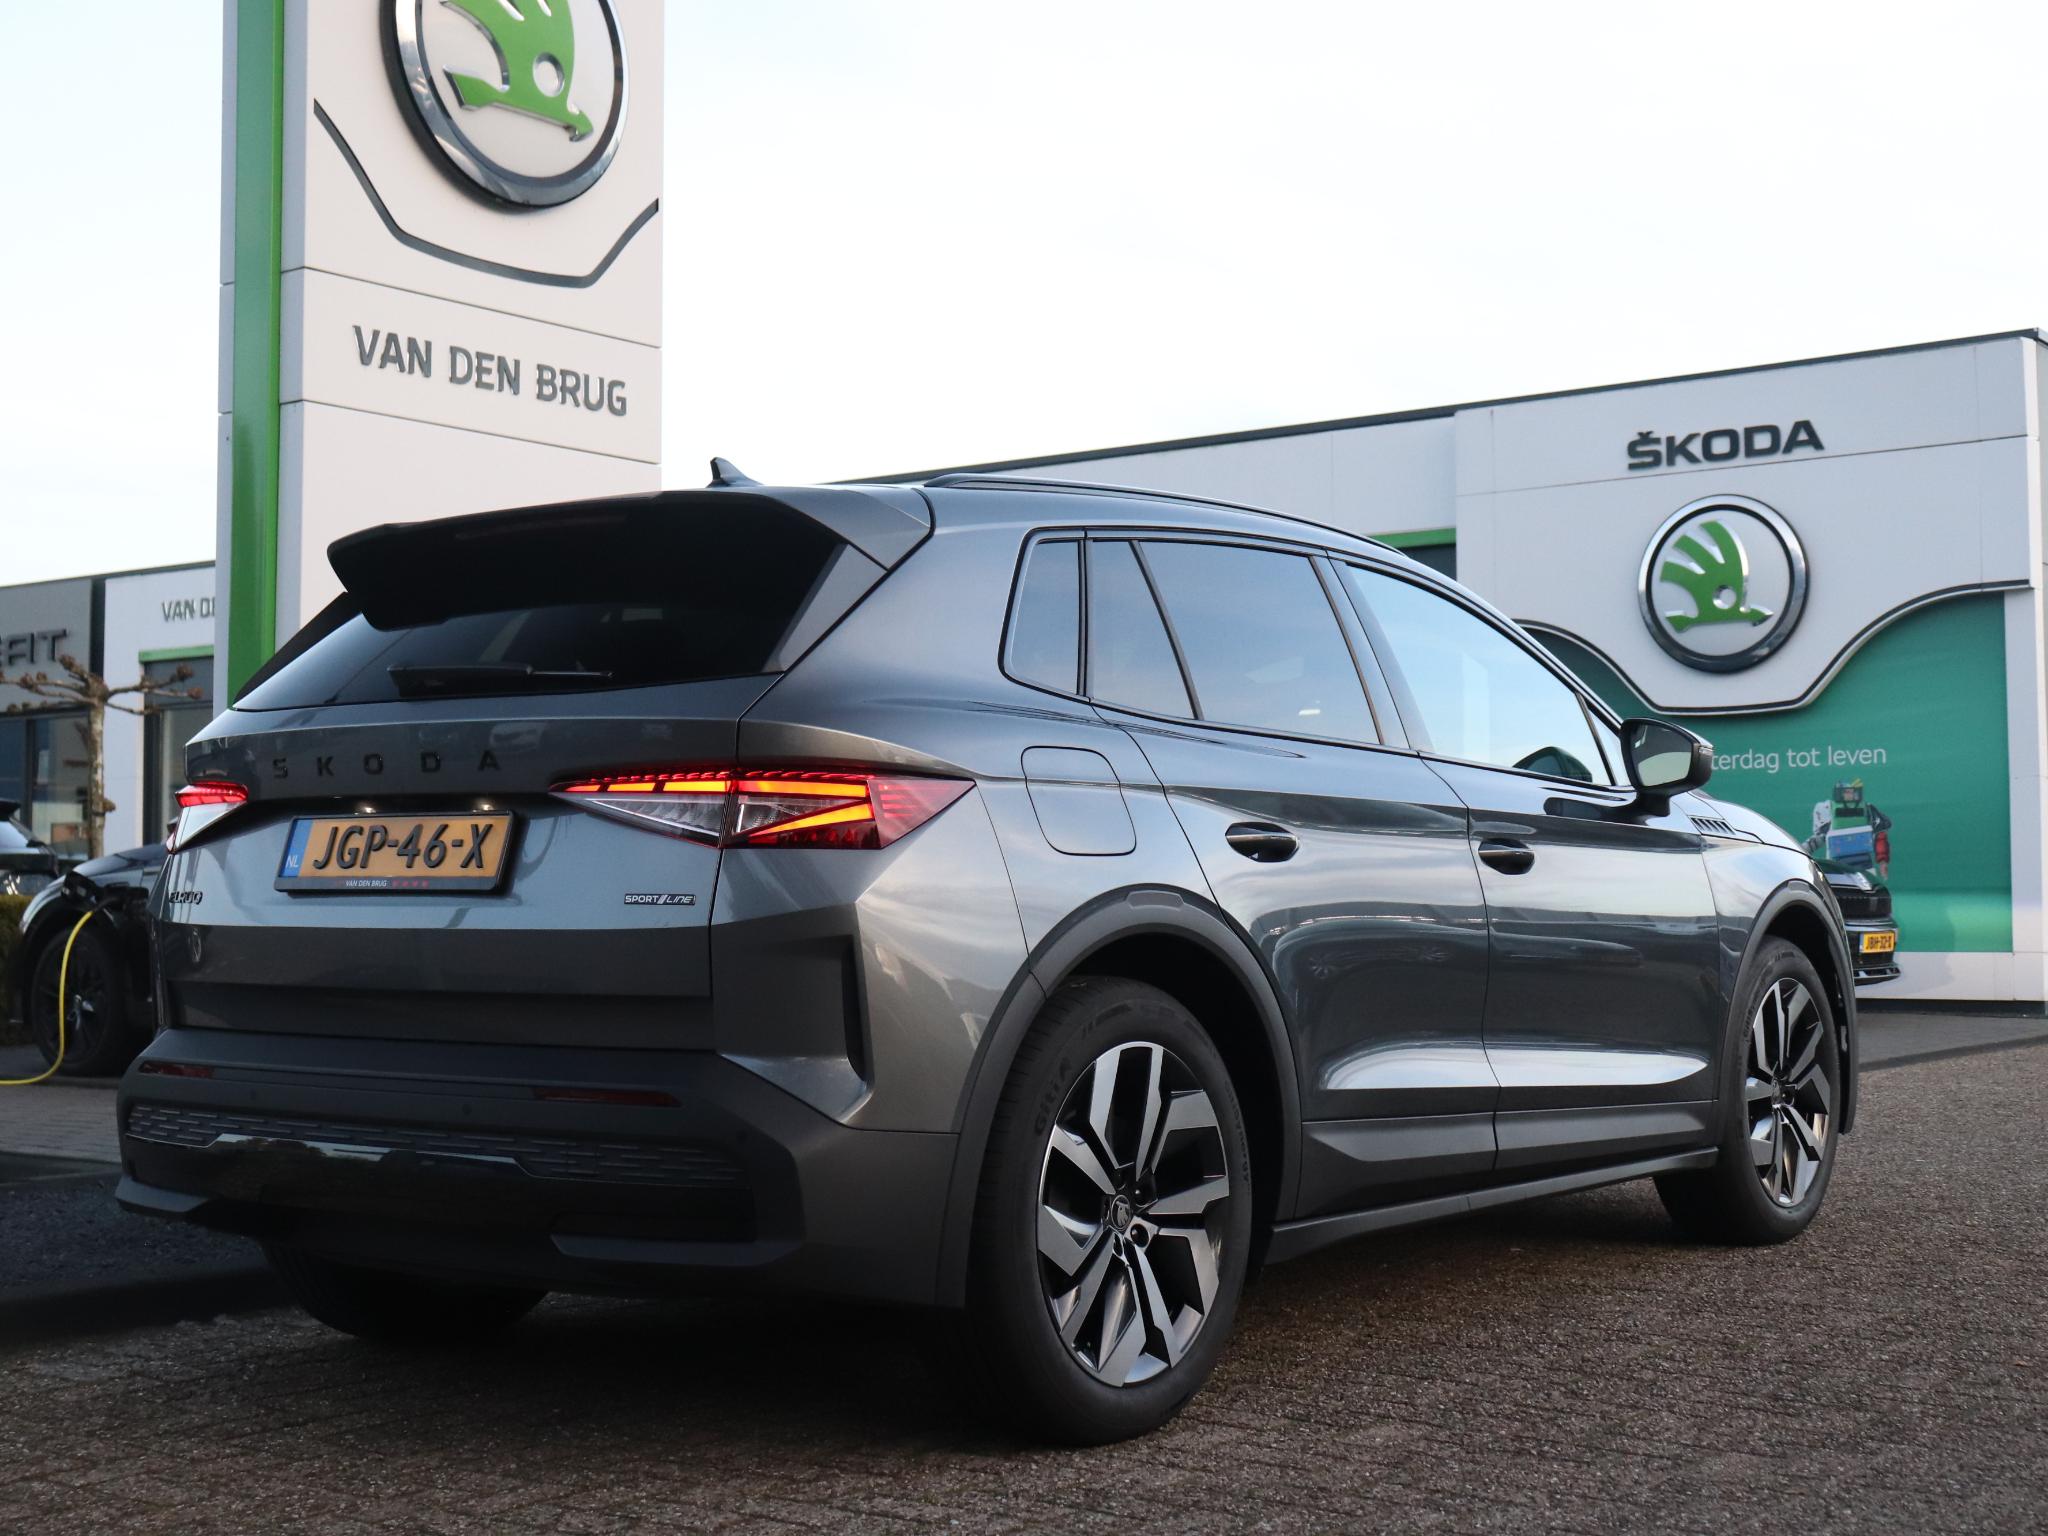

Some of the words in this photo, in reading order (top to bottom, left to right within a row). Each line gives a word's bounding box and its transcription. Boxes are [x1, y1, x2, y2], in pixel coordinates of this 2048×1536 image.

[352, 325, 432, 378] VAN
[449, 346, 521, 395] DEN
[536, 364, 627, 416] BRUG
[1627, 420, 1825, 470] ŠKODA
[162, 599, 195, 622] VAN
[0, 629, 67, 667] FIT
[1786, 748, 1821, 768] tot
[1828, 745, 1887, 766] leven
[286, 855, 299, 868] NL
[313, 823, 494, 869] JGP-46-X
